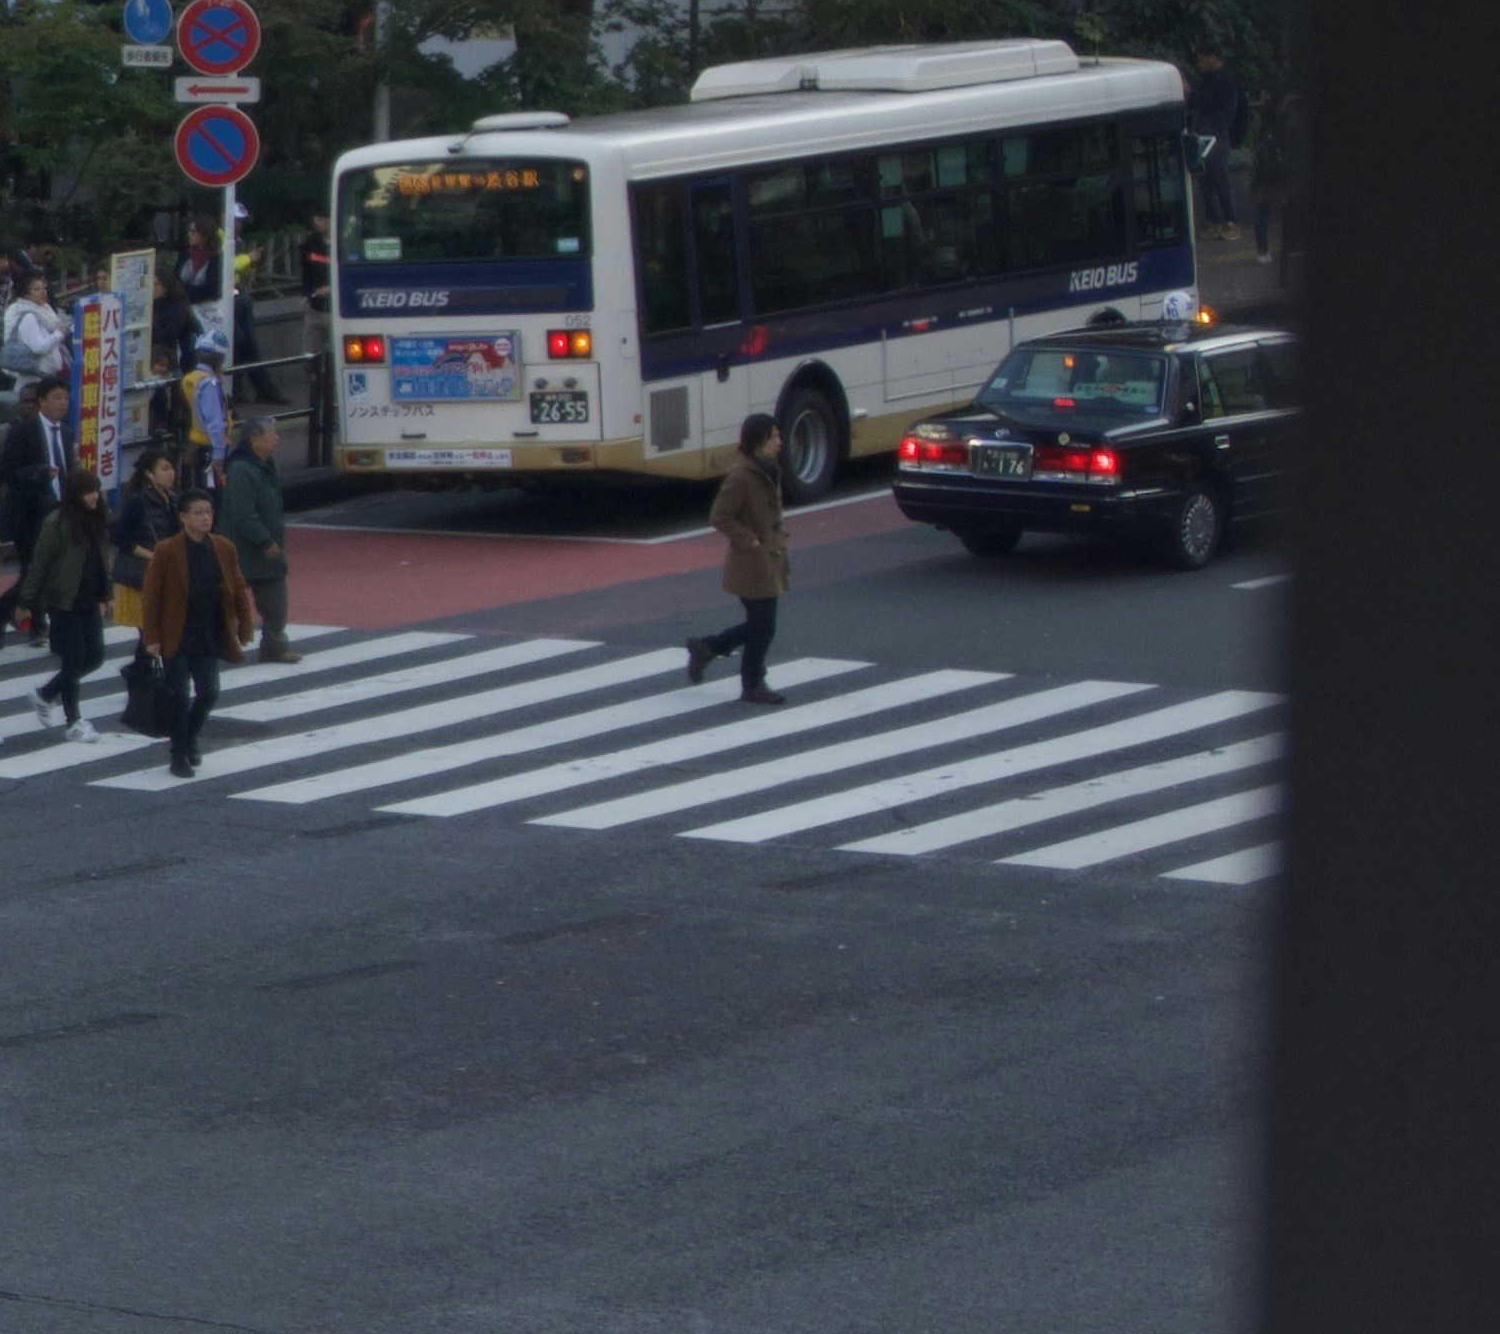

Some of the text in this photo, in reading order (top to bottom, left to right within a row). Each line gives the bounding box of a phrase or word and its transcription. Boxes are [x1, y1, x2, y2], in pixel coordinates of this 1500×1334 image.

[1069, 262, 1139, 292] KEIO BUS
[361, 291, 450, 308] KEIO BUS
[565, 315, 591, 327] 052
[100, 308, 120, 477] バス停につき
[350, 404, 436, 418] ノンステップバス
